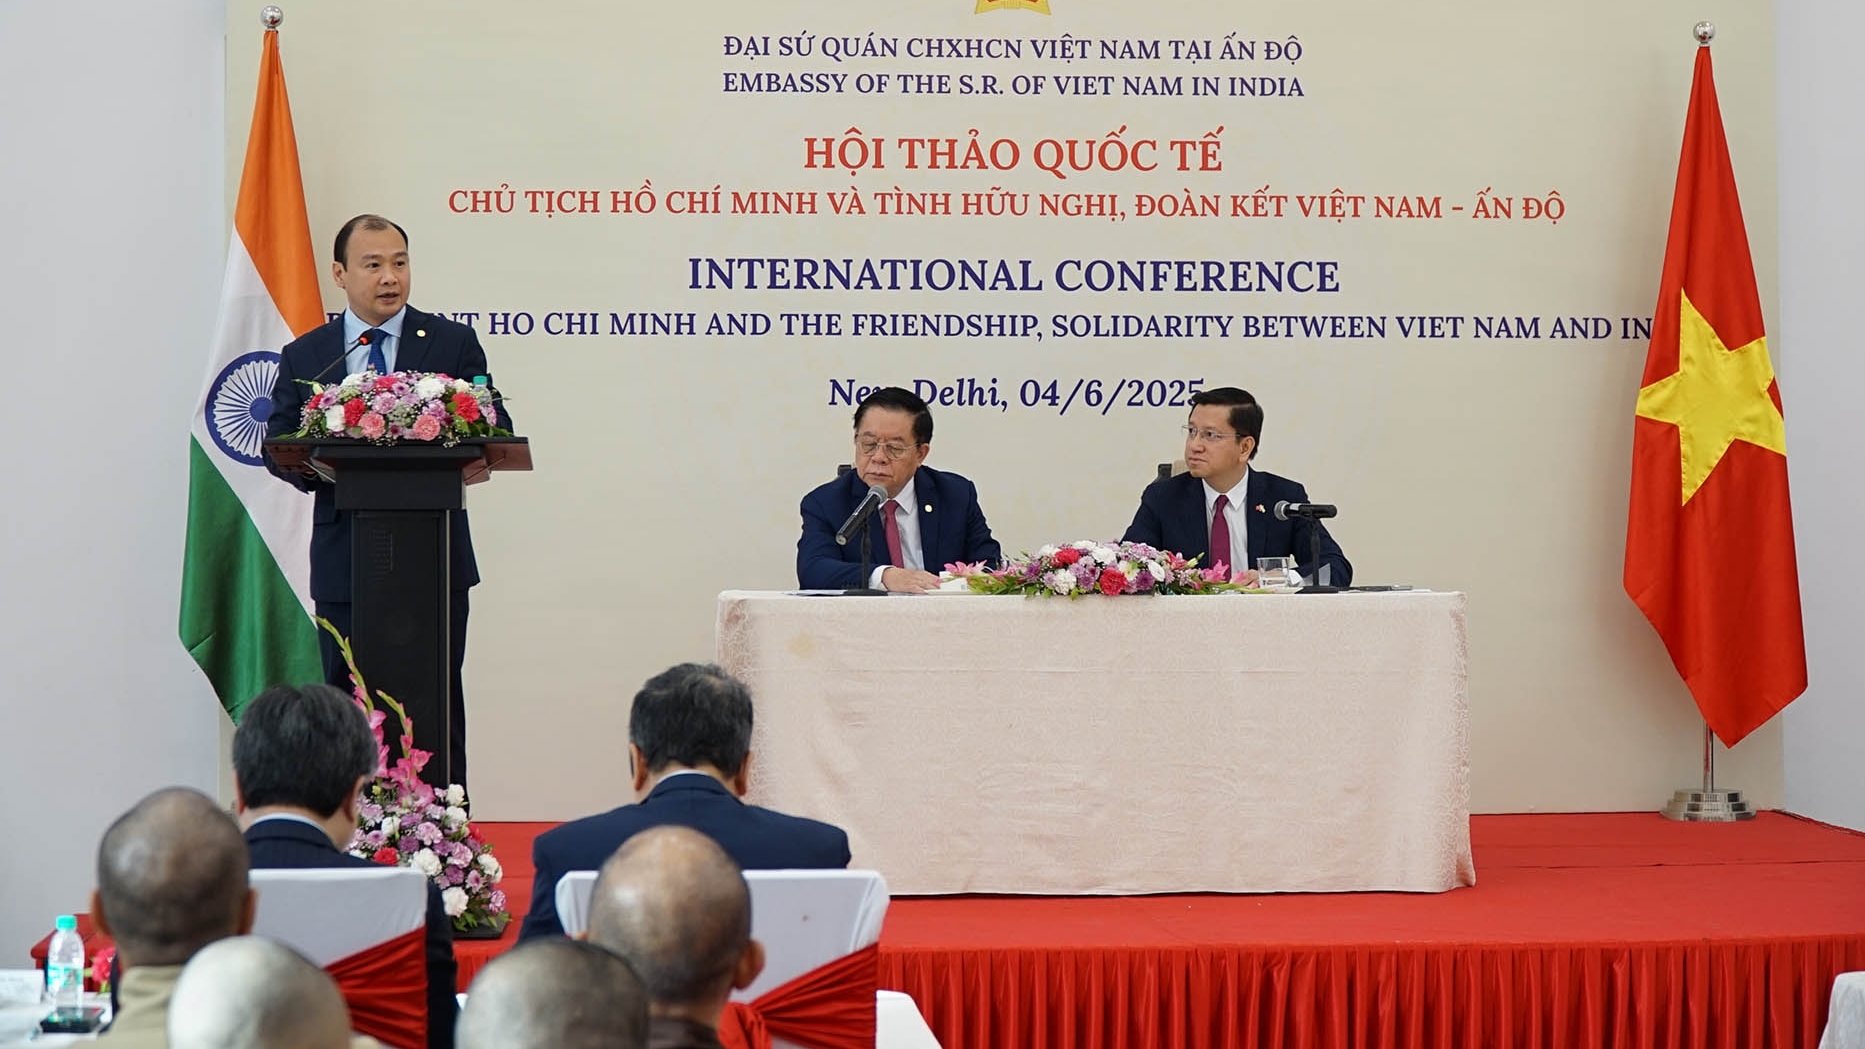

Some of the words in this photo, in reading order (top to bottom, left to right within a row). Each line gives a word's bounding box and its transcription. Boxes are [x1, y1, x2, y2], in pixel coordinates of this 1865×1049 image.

[724, 36, 770, 61] ĐẠI
[779, 30, 816, 57] SỨ
[822, 32, 898, 62] QUÁN
[907, 38, 1022, 59] CHXHCN
[1030, 33, 1092, 63] VIỆT
[1100, 40, 1160, 60] NAM
[1169, 40, 1211, 64] TẠI
[1220, 31, 1256, 60] ẤN
[1264, 35, 1303, 65] ĐỘ
[723, 73, 848, 93] EMBASSY
[856, 74, 889, 93] OF
[897, 74, 951, 94] THE
[960, 75, 1004, 94] S.R.
[1012, 75, 1046, 95] OF
[1053, 76, 1114, 95] VIET
[1123, 77, 1183, 96] NAM
[1192, 77, 1220, 96] IN
[1229, 77, 1304, 97] INDIA
[805, 127, 884, 177] HỘI
[898, 129, 1020, 170] THẢO
[1034, 125, 1157, 179] QUỐC
[1170, 126, 1225, 171] TẾ
[449, 183, 516, 213] CHỦ
[525, 191, 600, 218] TỊCH
[611, 179, 656, 213] HỒ
[666, 185, 721, 213] CHÍ
[731, 192, 817, 214] MINH
[827, 186, 866, 215] VÀ
[874, 186, 951, 215] TÌNH
[962, 187, 1030, 216] HỮU
[1040, 194, 1126, 221] NGHỊ,
[1135, 188, 1220, 217] ĐOÀN
[1231, 184, 1288, 217] KẾT
[1296, 188, 1365, 223] VIỆT
[1374, 196, 1442, 218] NAM
[1473, 187, 1513, 219] ẤN
[1523, 191, 1565, 225] ĐỘ
[689, 258, 1042, 291] INTERNATIONAL
[1056, 260, 1340, 292] CONFERENCE
[489, 313, 534, 336] HO
[544, 313, 600, 336] CHI
[610, 313, 696, 336] MINH
[705, 313, 771, 336] AND
[780, 314, 842, 336] THE
[852, 314, 1043, 342] FRIENDSHIP,
[1052, 315, 1235, 338] SOLIDARITY
[1243, 316, 1386, 339] BETWEEN
[1396, 316, 1465, 339] VIET
[1473, 317, 1541, 339] NAM
[1550, 317, 1612, 339] AND
[828, 379, 883, 406] Ne
[912, 378, 1008, 412] Delhi,
[1020, 378, 1205, 416] 04/6/2025
